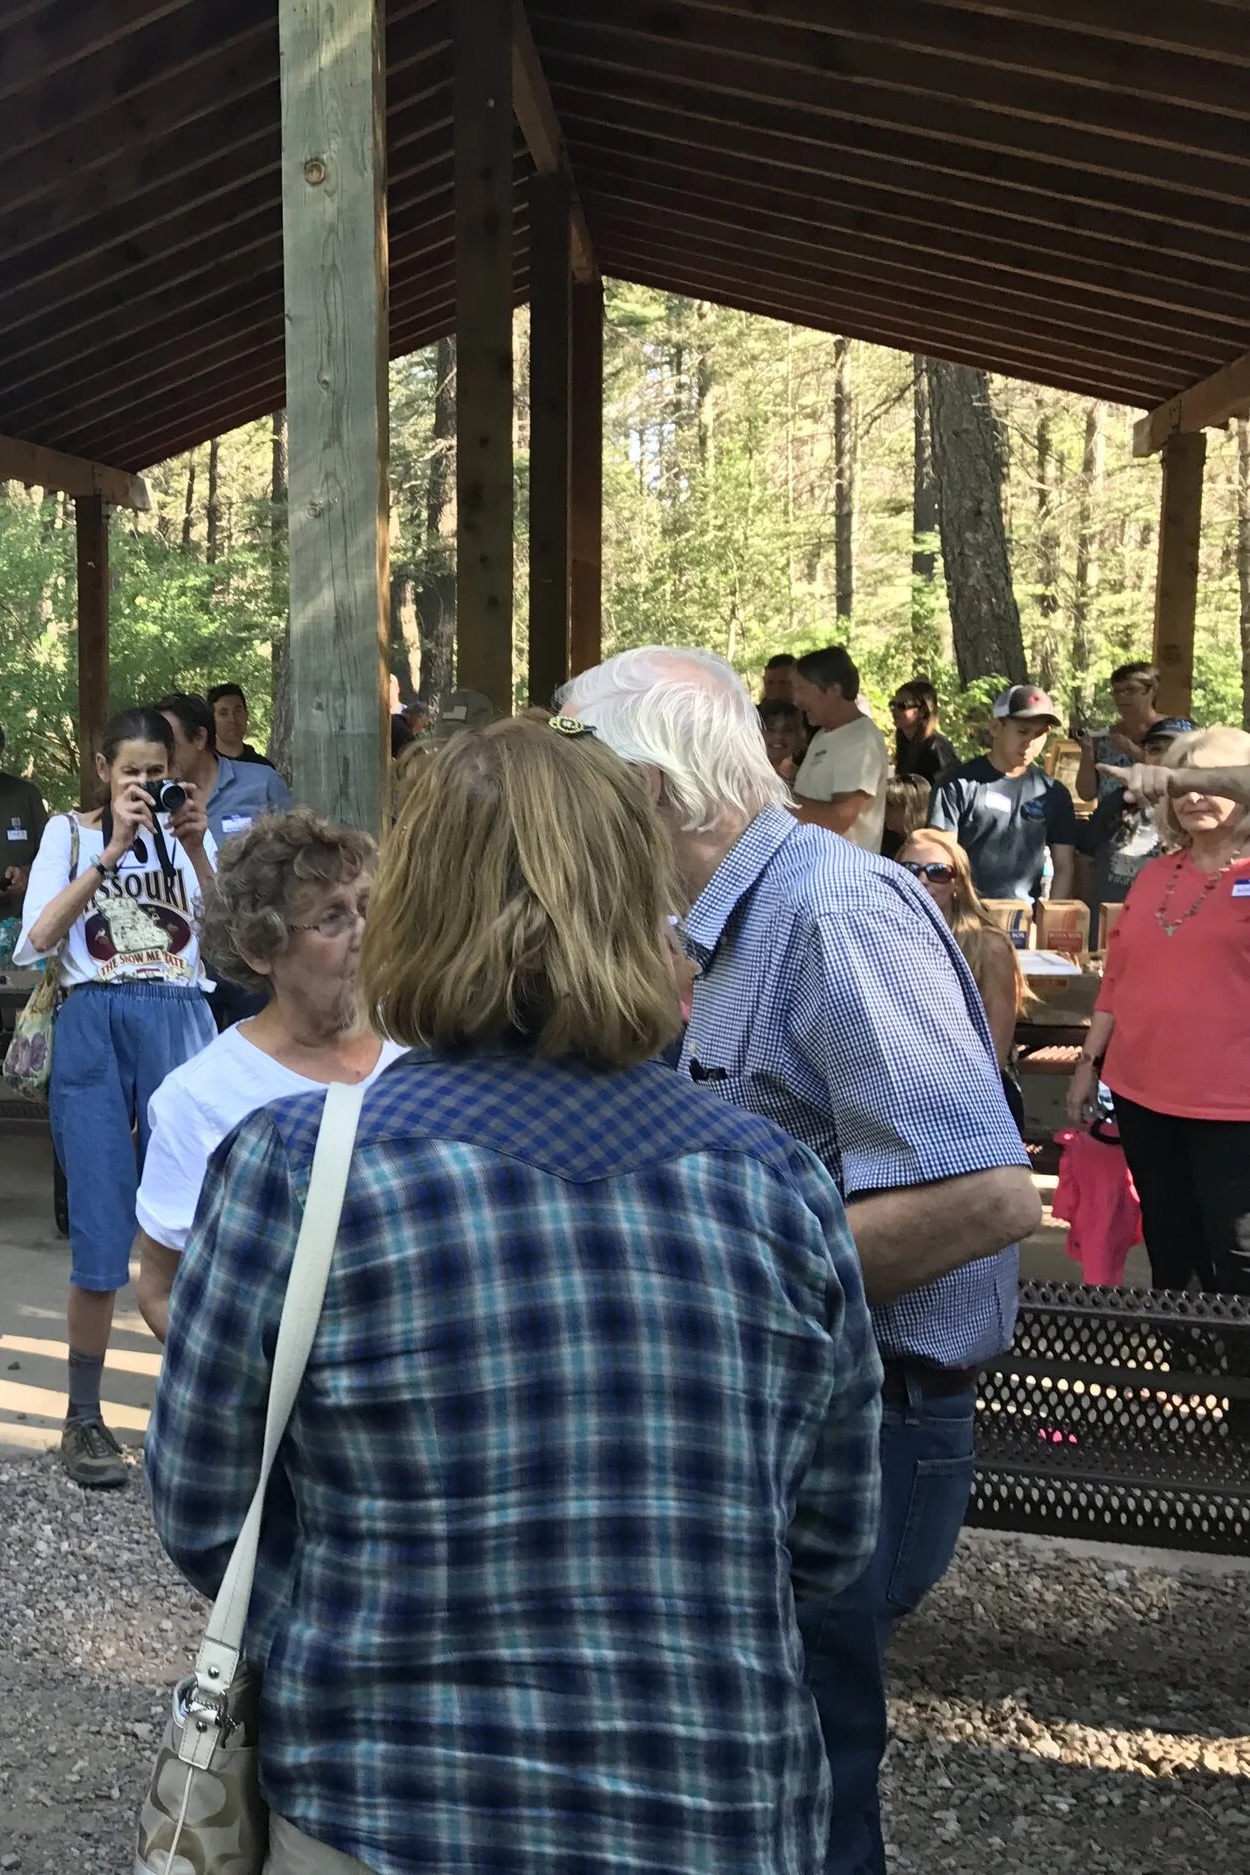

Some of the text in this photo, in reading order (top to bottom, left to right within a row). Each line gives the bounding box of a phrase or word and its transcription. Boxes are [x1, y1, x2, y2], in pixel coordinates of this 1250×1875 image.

[101, 950, 185, 976] THE SHOW ME TATE
